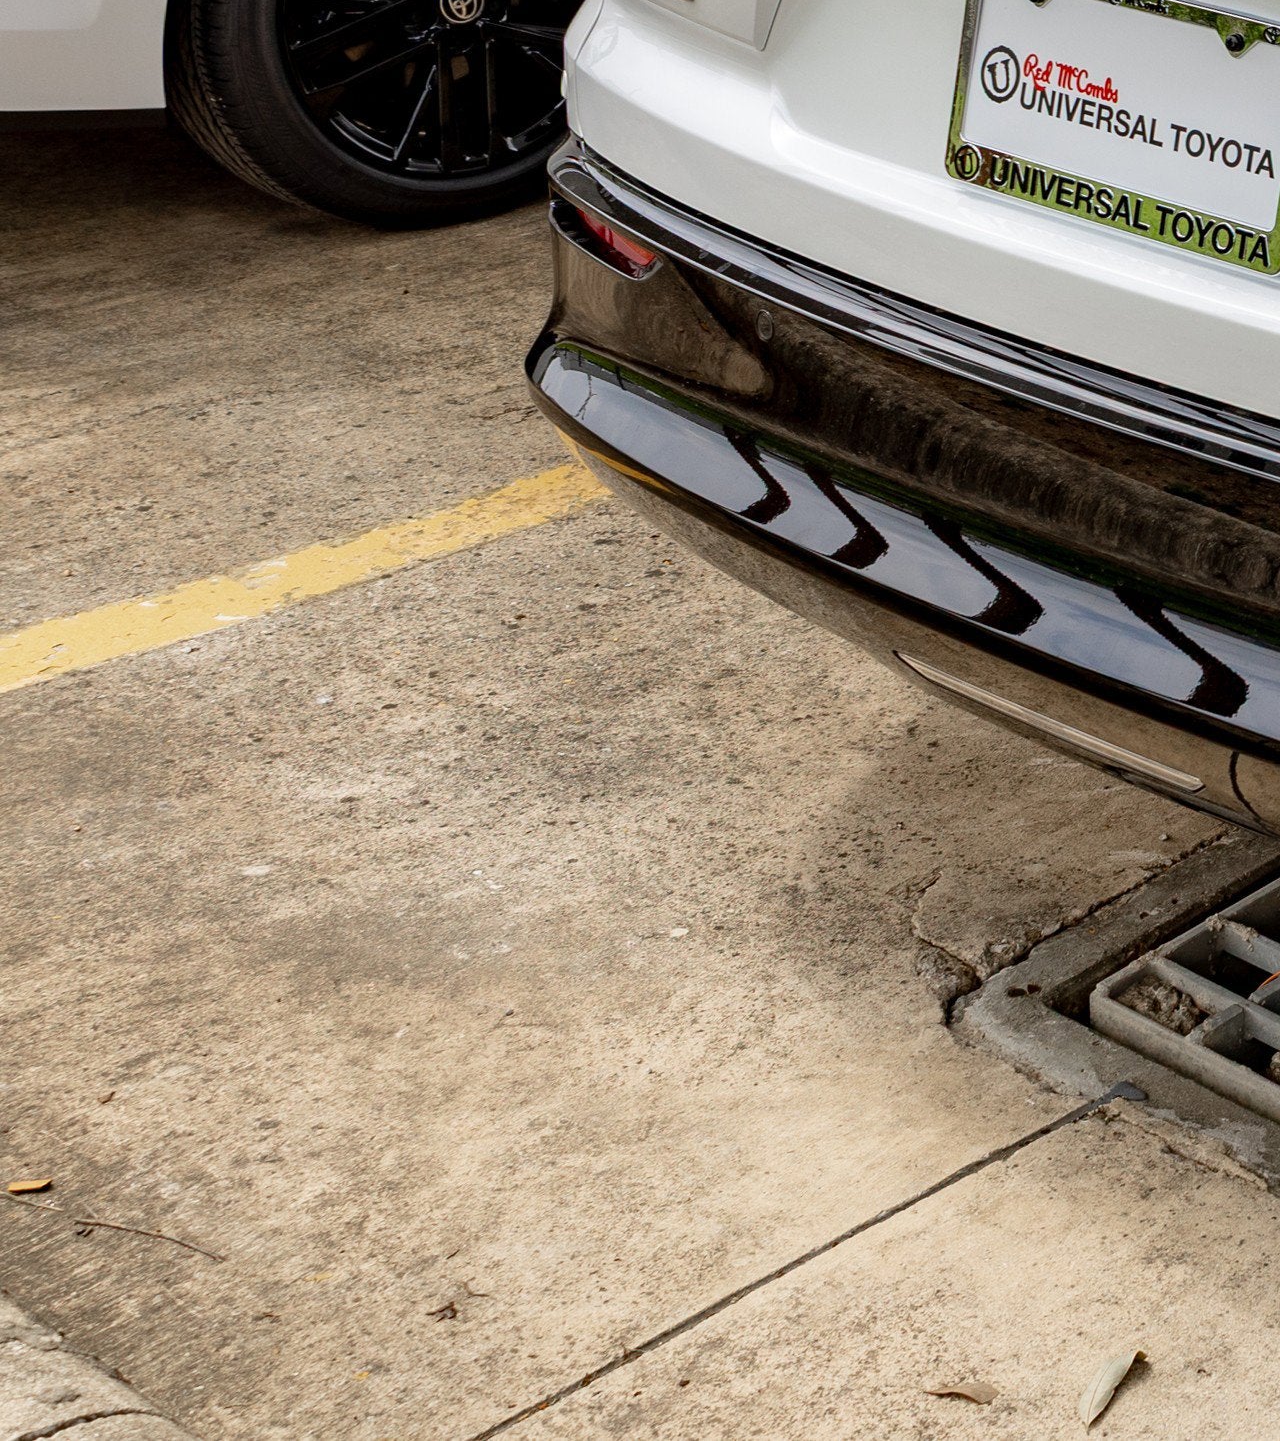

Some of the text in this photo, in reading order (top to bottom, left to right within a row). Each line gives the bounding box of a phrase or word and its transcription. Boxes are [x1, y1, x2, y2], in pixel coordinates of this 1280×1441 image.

[1024, 54, 1119, 104] Red McCombs
[1020, 81, 1274, 179] UNIVERSAL TOYOTA
[990, 154, 1149, 233] UNIVERSAL
[1156, 204, 1271, 269] TOYOTA
